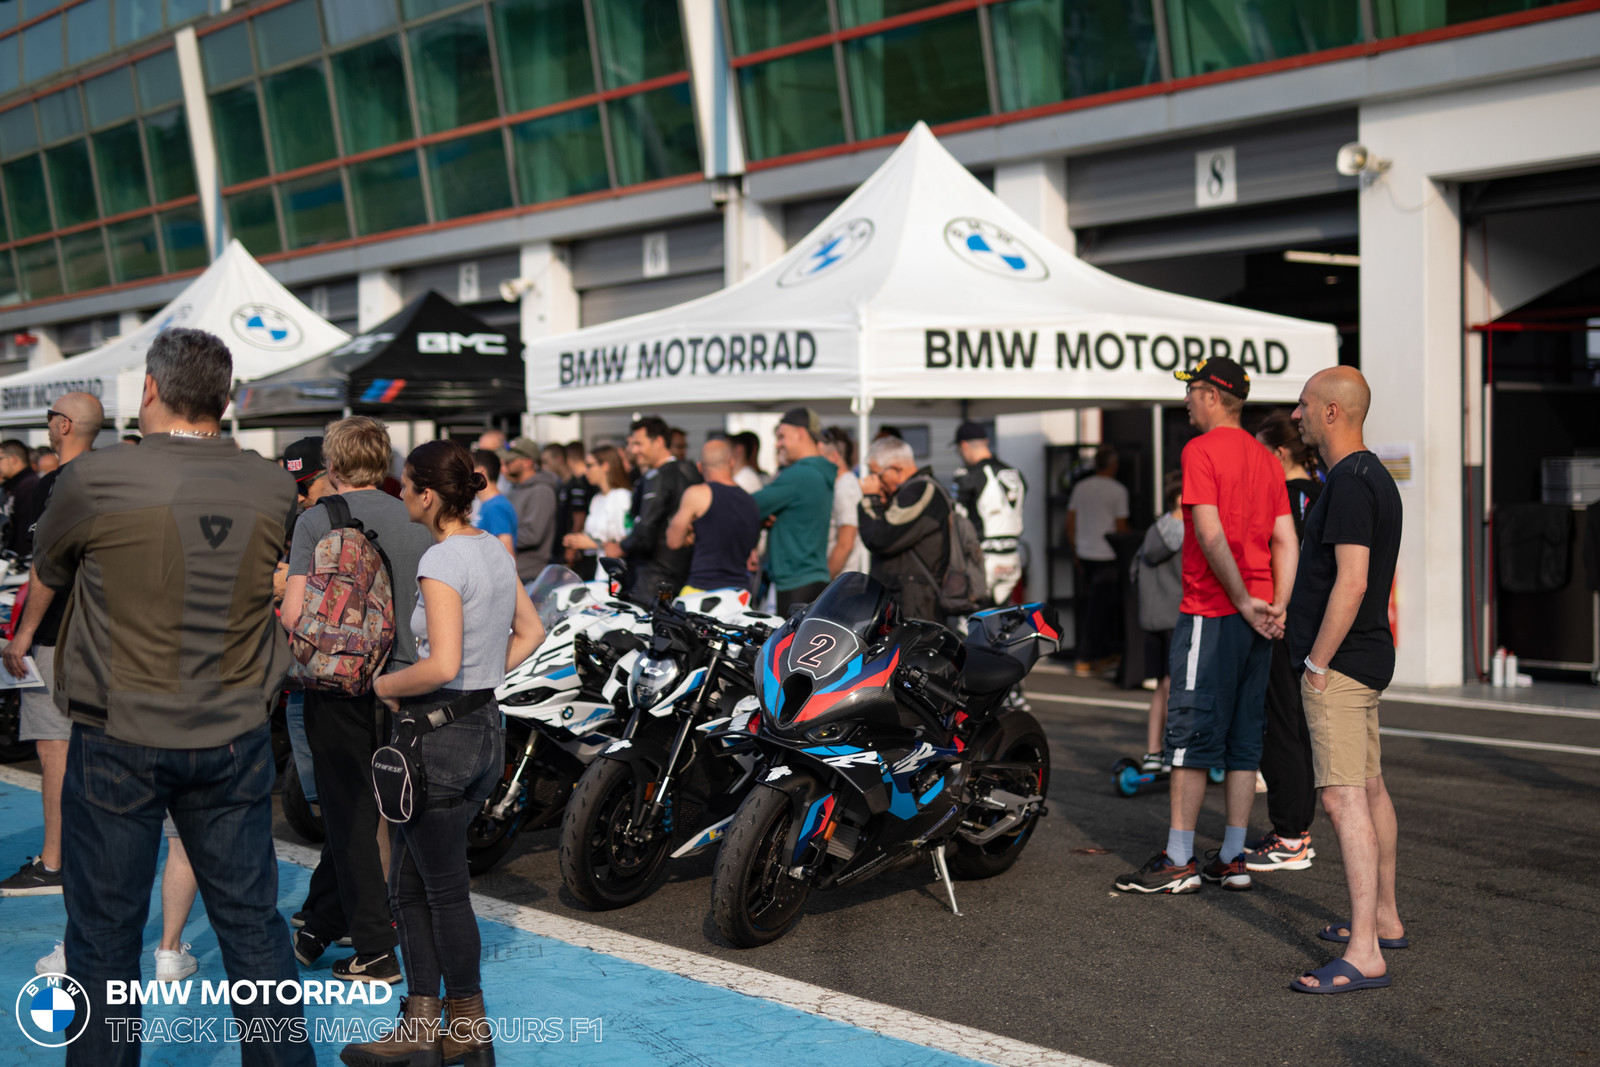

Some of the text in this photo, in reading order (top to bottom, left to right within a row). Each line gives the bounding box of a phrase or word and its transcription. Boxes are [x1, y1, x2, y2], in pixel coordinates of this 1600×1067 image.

[1207, 152, 1225, 200] 8
[560, 330, 817, 386] BMW MOTORRAD
[925, 329, 1038, 369] BMW
[797, 633, 837, 668] 2
